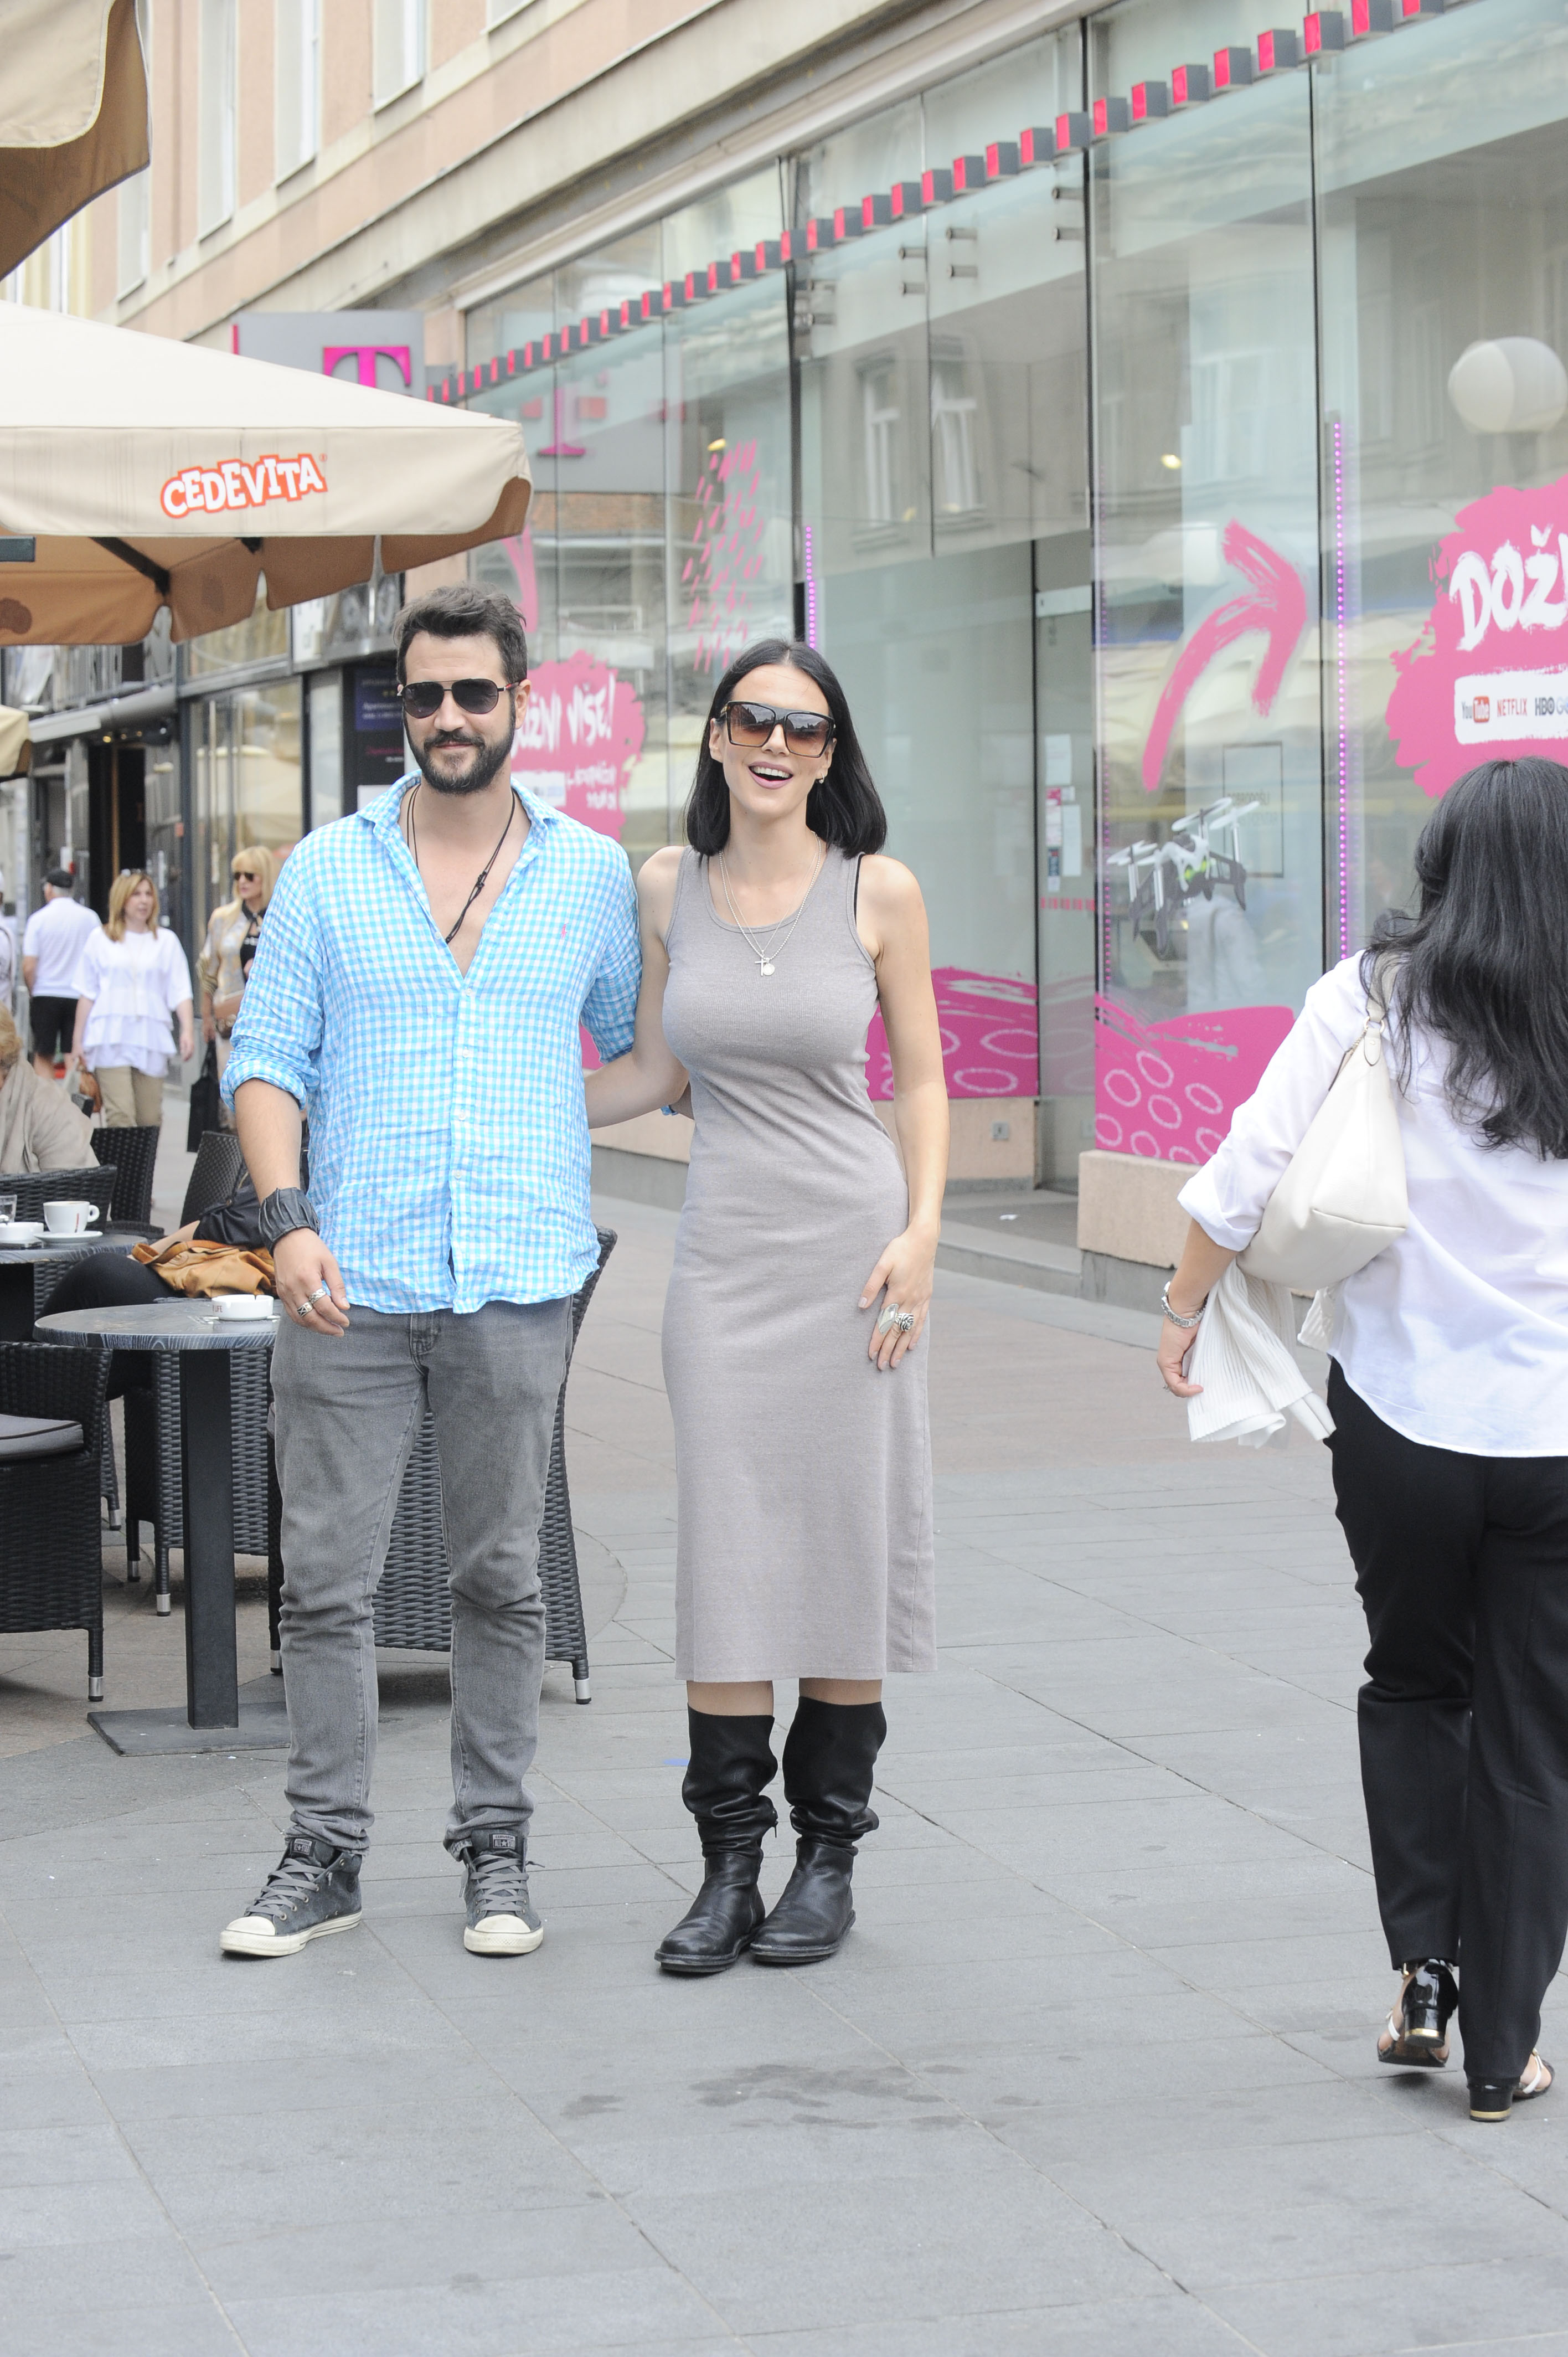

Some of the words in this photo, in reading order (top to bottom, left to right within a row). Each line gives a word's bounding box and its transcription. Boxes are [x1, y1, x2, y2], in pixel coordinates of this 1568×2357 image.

[162, 455, 327, 518] CEDEVITA
[1462, 697, 1490, 723] YouTube
[1497, 698, 1527, 717] NETFLIX
[1535, 697, 1555, 716] HBO
